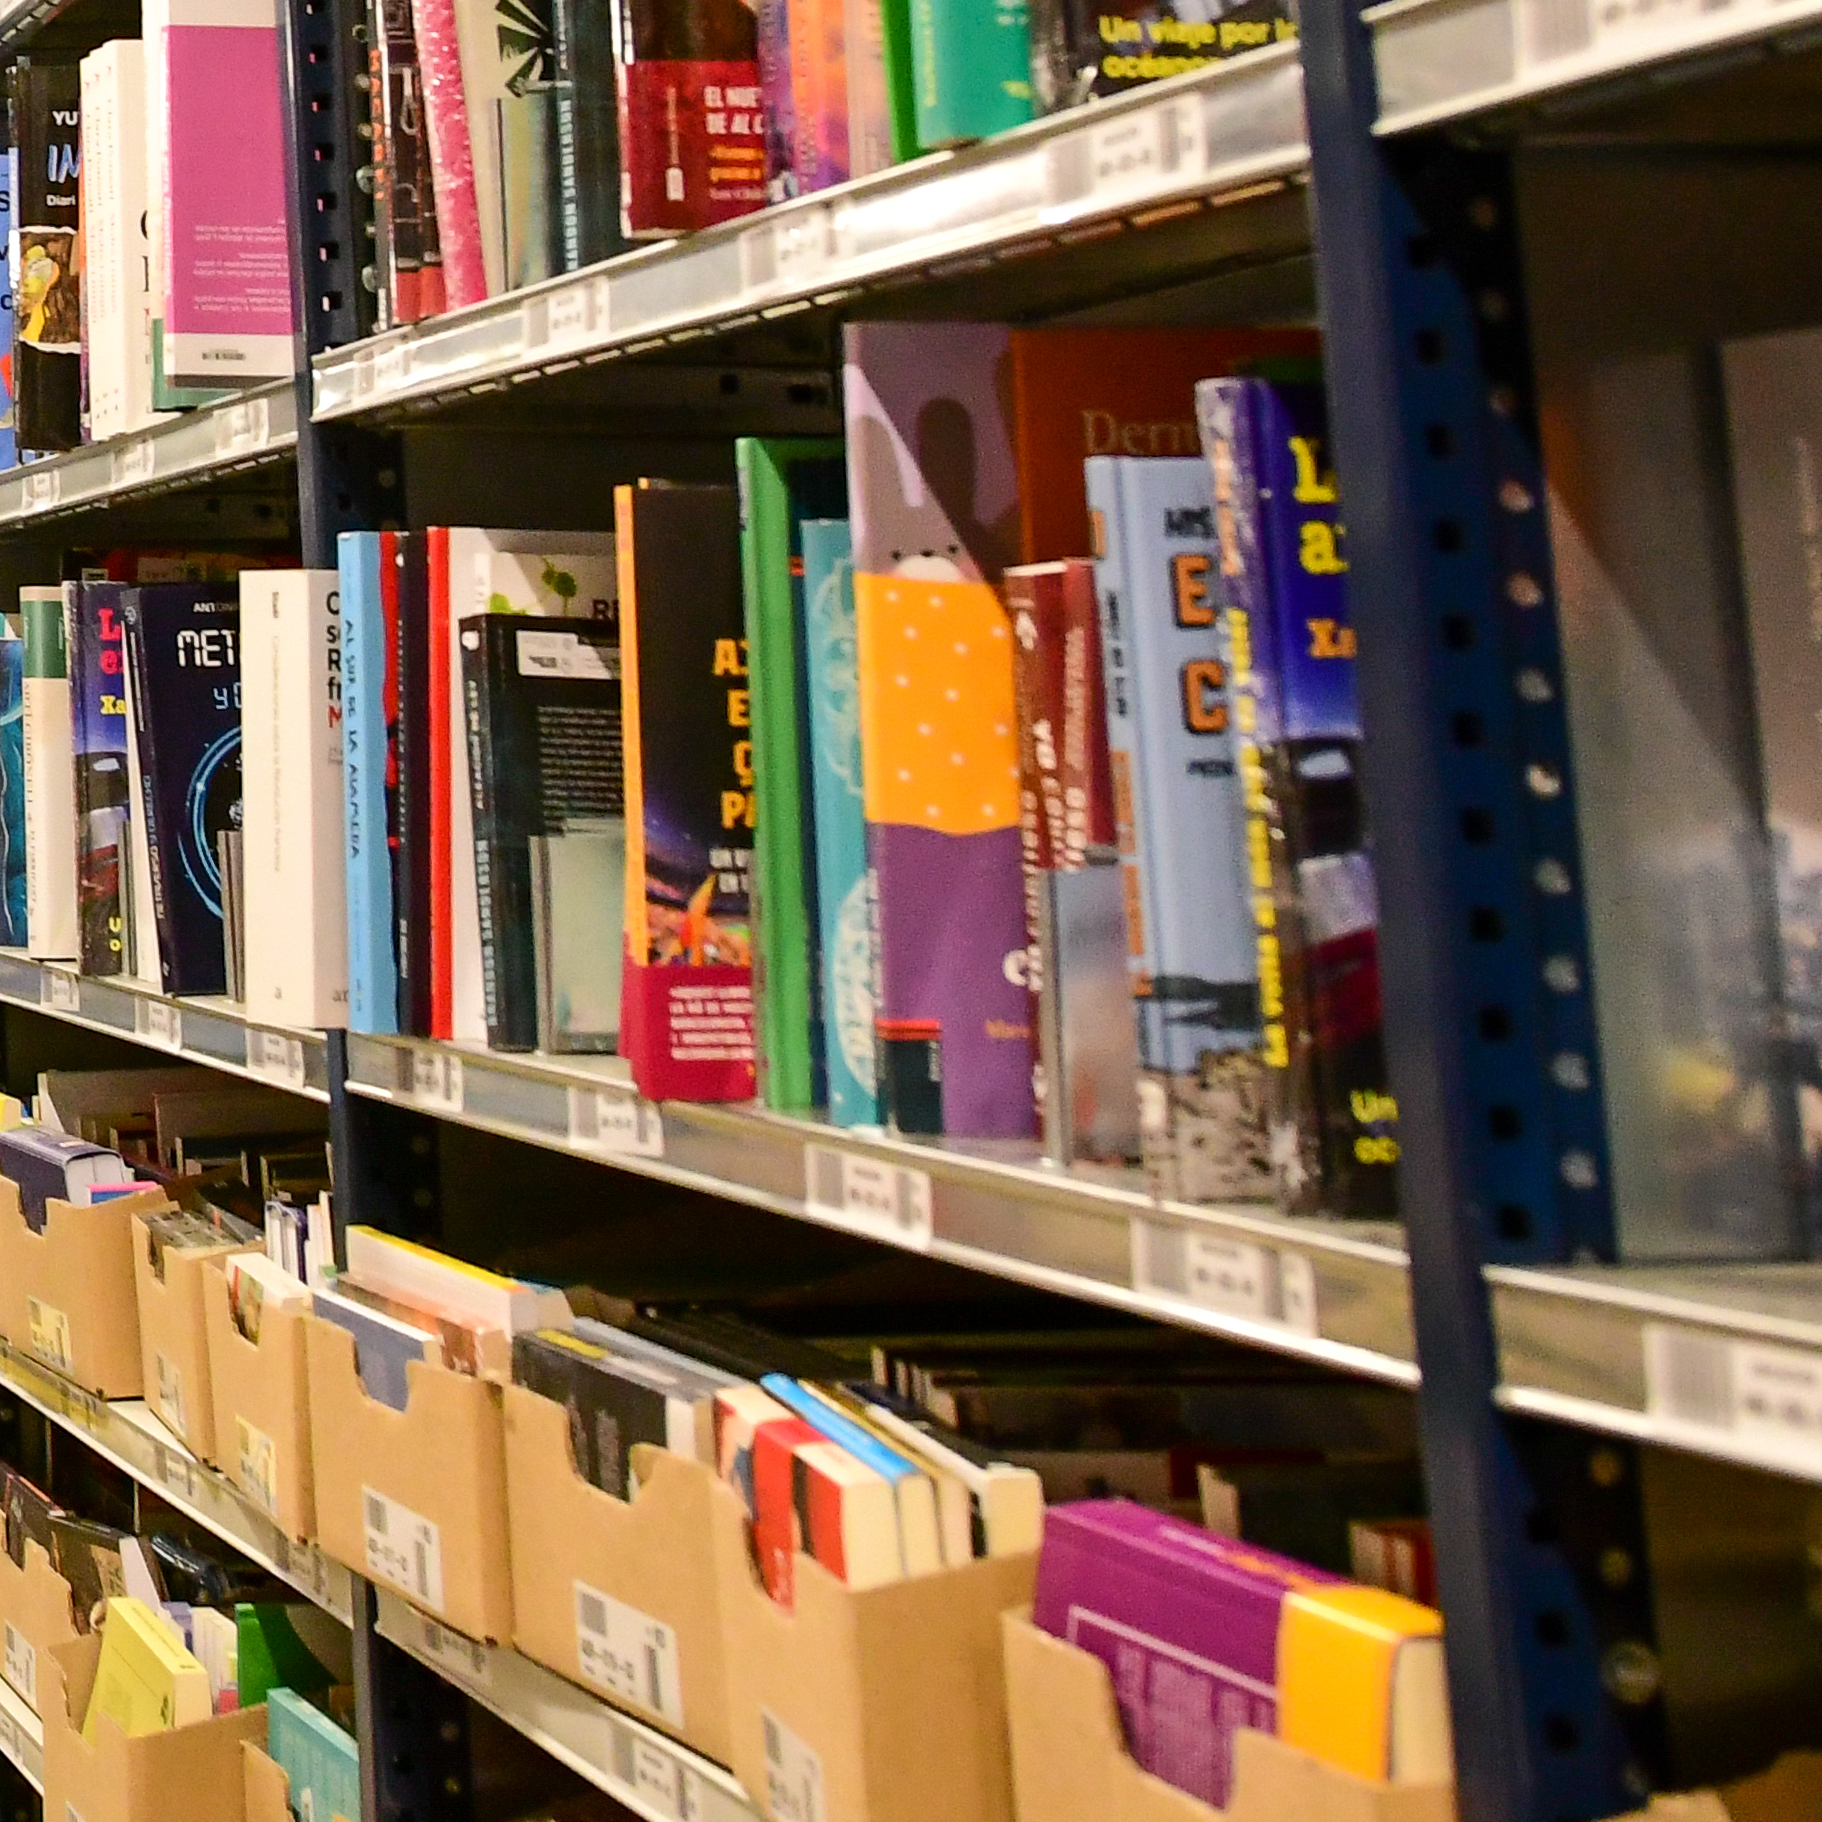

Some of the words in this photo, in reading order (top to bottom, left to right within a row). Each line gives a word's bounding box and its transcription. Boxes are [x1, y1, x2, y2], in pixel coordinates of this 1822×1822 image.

[1099, 14, 1143, 45] Un
[1148, 15, 1218, 50] viaje
[1219, 20, 1271, 51] por
[345, 654, 357, 688] SUR
